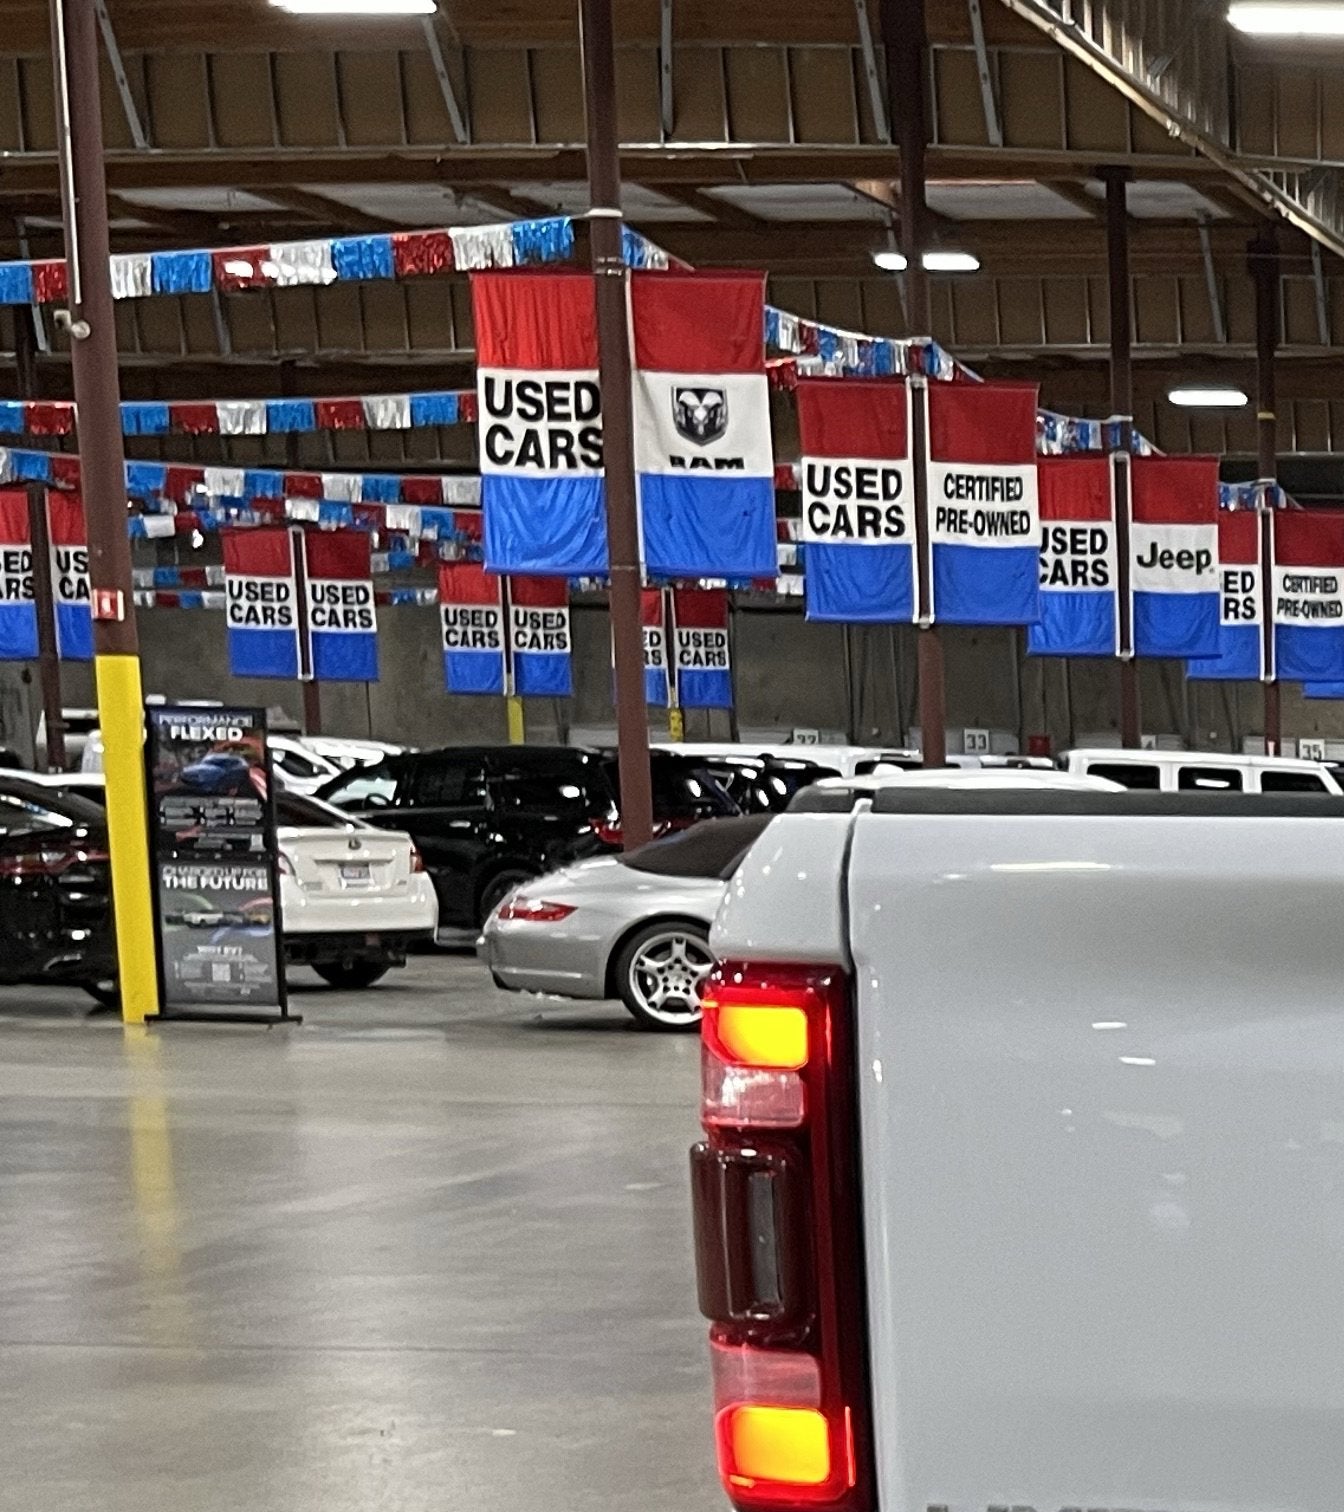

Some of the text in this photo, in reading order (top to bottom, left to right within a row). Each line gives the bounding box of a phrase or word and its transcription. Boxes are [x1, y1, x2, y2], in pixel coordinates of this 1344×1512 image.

[484, 377, 600, 422] USED
[485, 424, 603, 469] CARS
[669, 455, 745, 470] RAM
[807, 464, 902, 501] USED
[944, 472, 1024, 501] CERTIFIED
[808, 501, 906, 538] CARS
[936, 506, 1031, 536] PRE-OWNED
[0, 551, 33, 573] ED
[56, 550, 89, 574] US
[1136, 542, 1212, 575] Jeep
[0, 576, 35, 600] RS
[59, 577, 90, 600] CA
[228, 580, 290, 602] USED
[1224, 571, 1255, 594] ED
[1282, 574, 1338, 594] CERTIFIED
[311, 584, 369, 605] USED
[230, 603, 292, 625] CARS
[311, 607, 373, 628] CARS
[444, 608, 498, 628] USED
[514, 608, 566, 630] USED
[1224, 598, 1256, 620] RS
[1277, 598, 1343, 618] PRE-OWNED
[445, 628, 500, 648] CARS
[514, 630, 568, 650] CARS
[678, 631, 726, 648] USED
[679, 649, 726, 666] CARS
[170, 725, 244, 741] FLEXED
[966, 733, 988, 750] 33
[1302, 744, 1323, 760] 35
[164, 876, 268, 891] THE FUTURE
